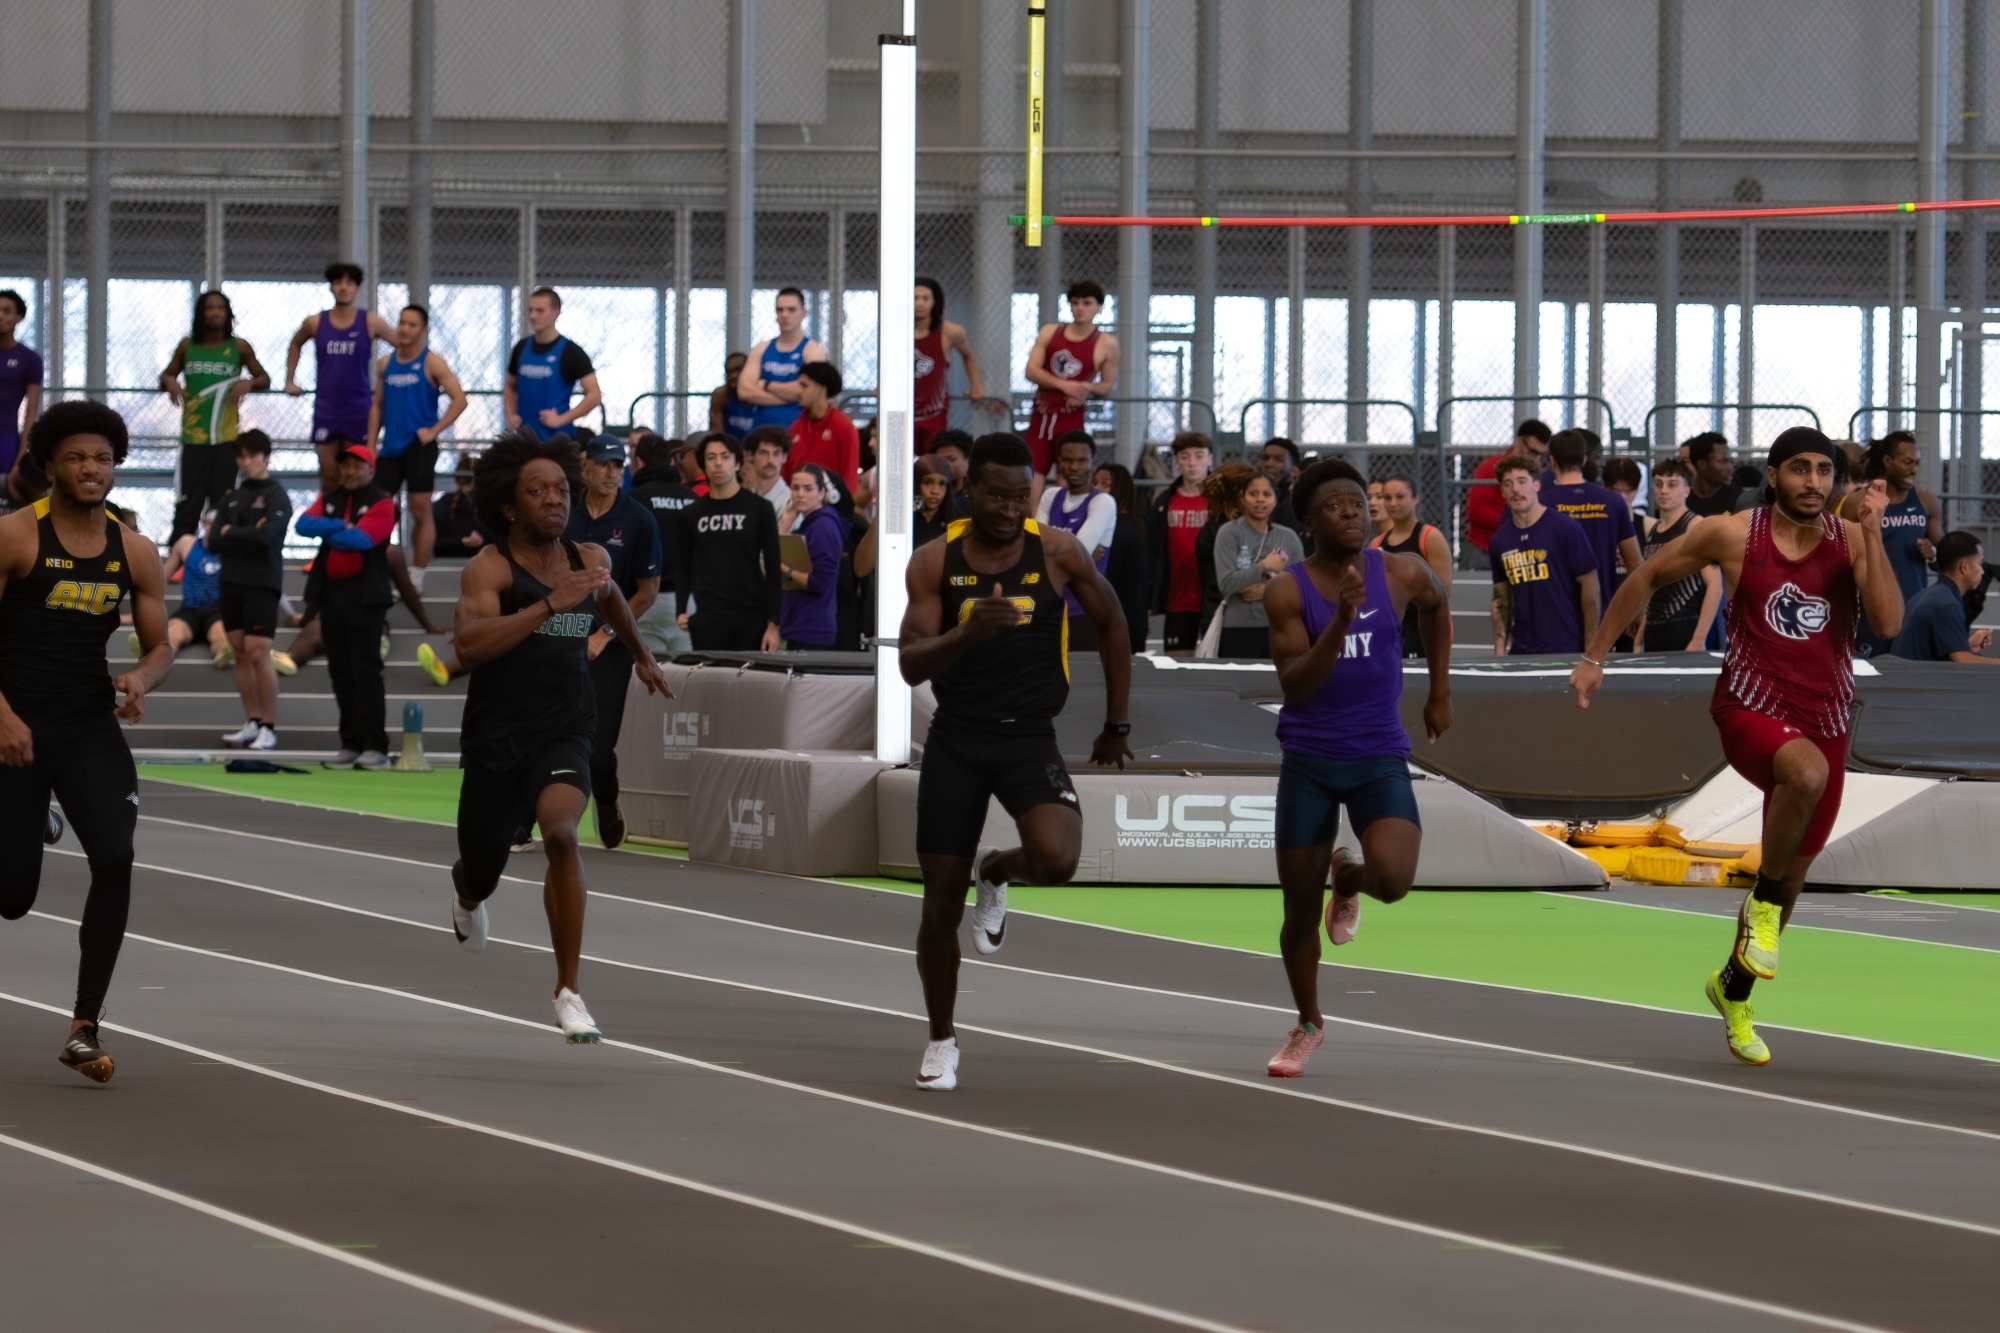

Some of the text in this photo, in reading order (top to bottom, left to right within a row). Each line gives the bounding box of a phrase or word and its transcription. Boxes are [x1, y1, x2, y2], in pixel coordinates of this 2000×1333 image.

[697, 514, 746, 533] CCNY
[1881, 514, 1927, 528] OWARD
[1513, 563, 1550, 585] FIELD
[45, 580, 120, 615] AIC
[663, 712, 699, 746] UCS
[1115, 794, 1277, 832] UCS
